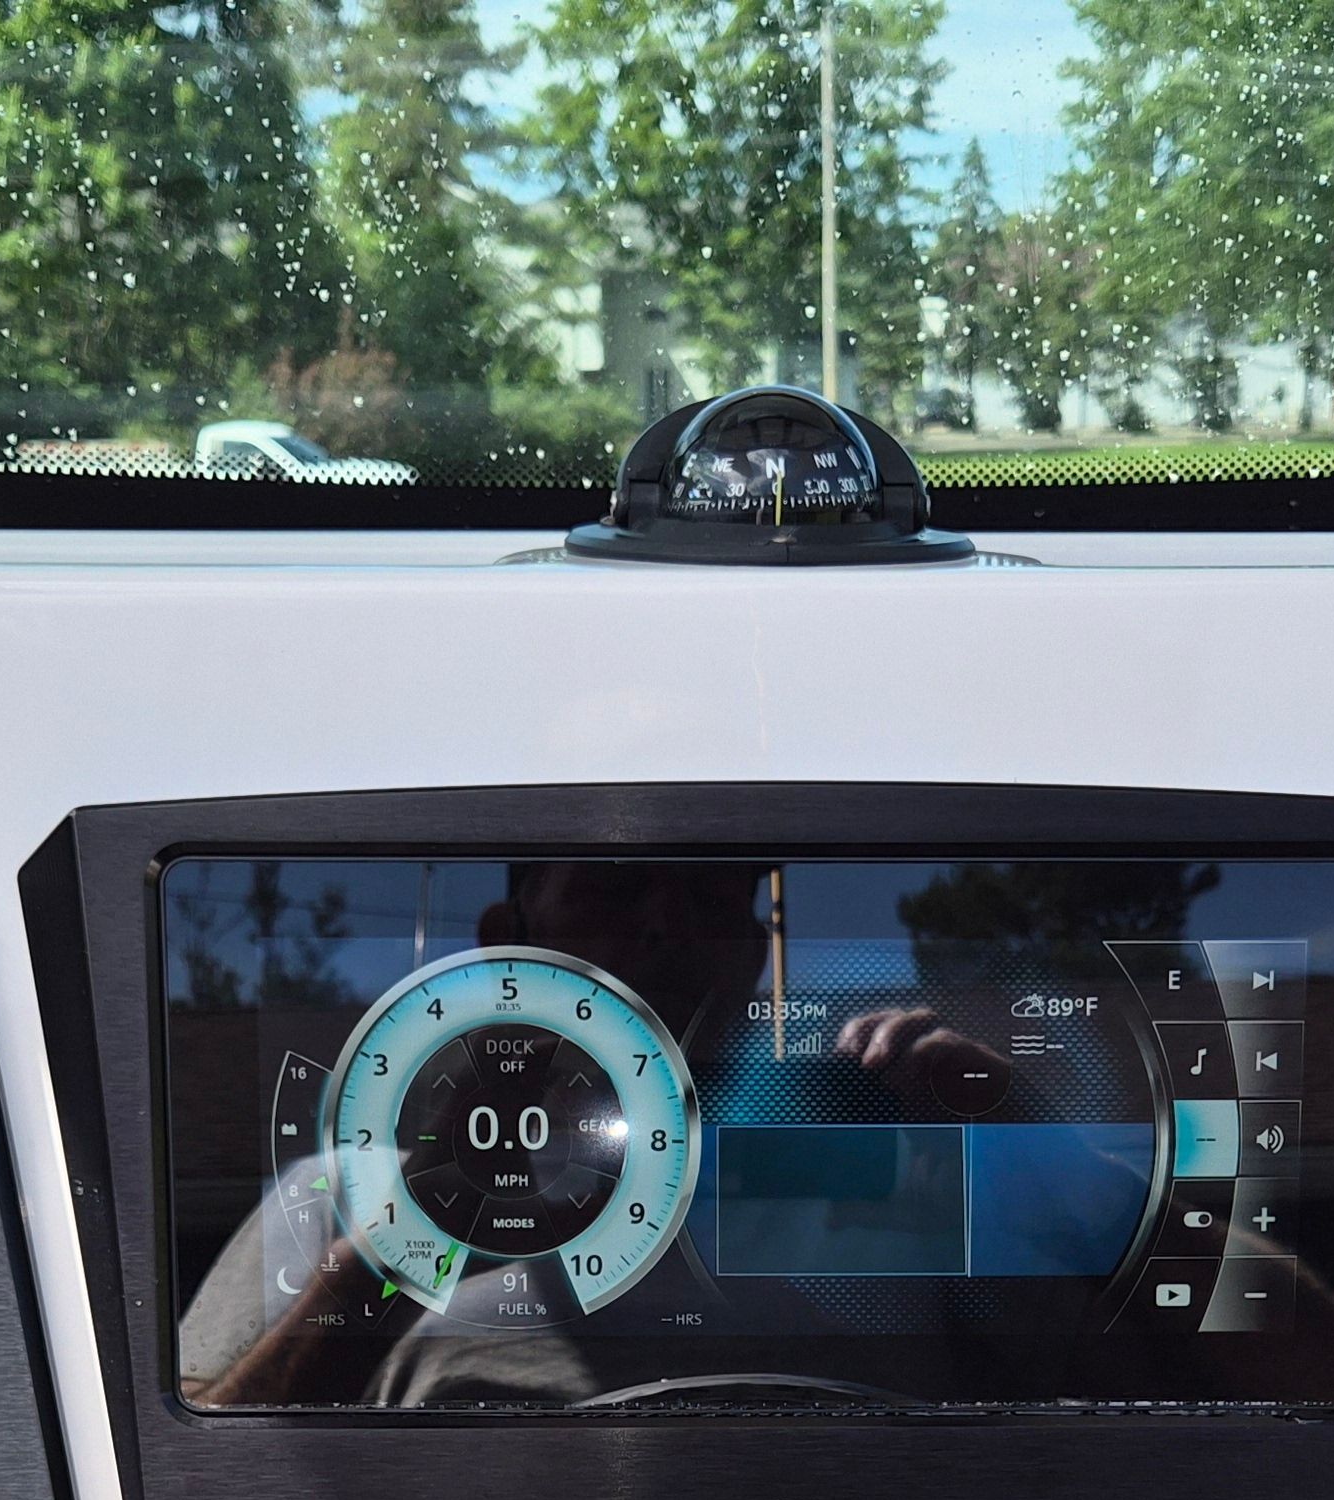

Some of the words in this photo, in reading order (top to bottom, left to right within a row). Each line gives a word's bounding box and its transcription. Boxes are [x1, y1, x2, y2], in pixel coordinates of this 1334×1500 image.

[765, 455, 786, 479] N
[813, 452, 838, 469] NW
[725, 483, 747, 497] 30
[501, 977, 518, 1001] 5
[427, 998, 444, 1021] 4
[575, 998, 593, 1021] 6
[486, 1039, 535, 1055] DOCK
[290, 1066, 307, 1080] 16
[372, 1054, 389, 1076] 3
[499, 1060, 526, 1073] OFF
[632, 1054, 649, 1076] 7
[467, 1105, 550, 1151] 0.0
[357, 1129, 373, 1152] 2
[650, 1129, 667, 1152] 8
[289, 1185, 299, 1197] 8
[494, 1174, 529, 1188] MPH
[298, 1210, 309, 1223] H
[384, 1202, 395, 1225] 1
[492, 1217, 536, 1229] MODES
[629, 1202, 645, 1225] 9
[405, 1240, 435, 1249] X1000
[408, 1251, 432, 1259] RPM
[571, 1254, 603, 1277] 10
[503, 1272, 529, 1293] 91
[364, 1303, 373, 1316] L
[498, 1304, 531, 1315] FUEL
[535, 1303, 547, 1315] %
